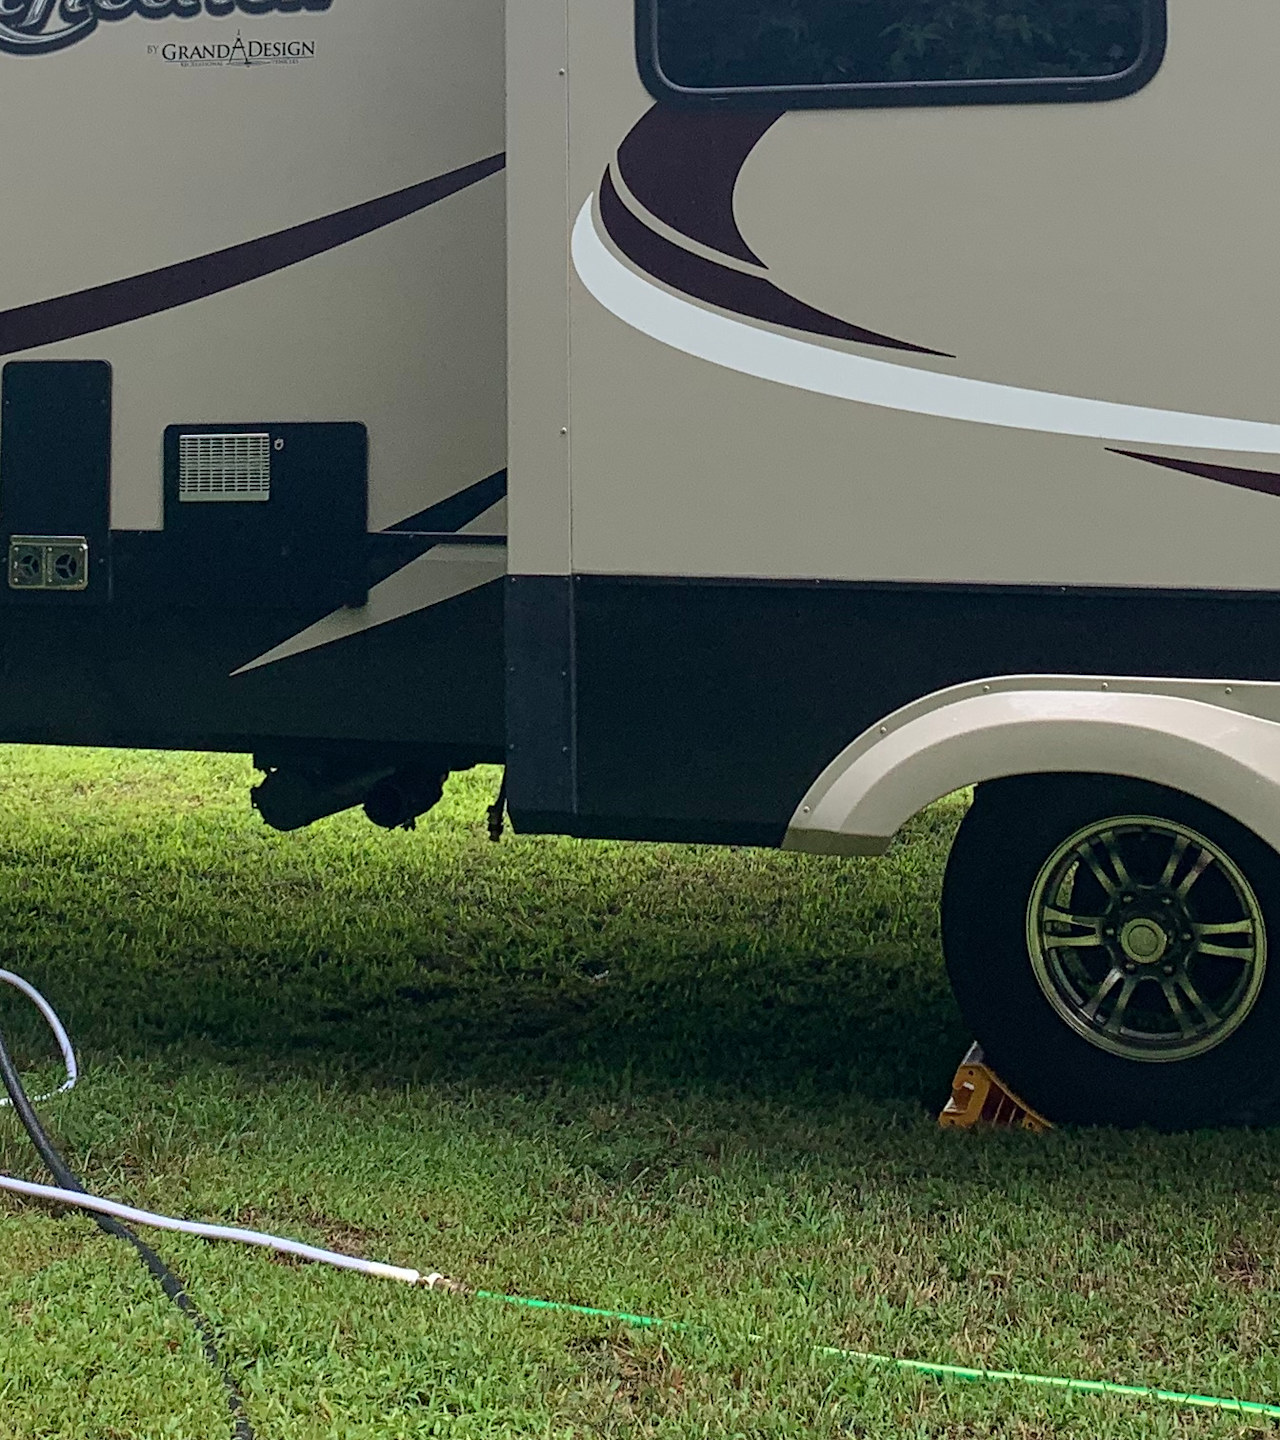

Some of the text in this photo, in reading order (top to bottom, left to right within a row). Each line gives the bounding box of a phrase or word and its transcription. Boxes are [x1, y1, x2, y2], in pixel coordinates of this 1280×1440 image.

[146, 40, 315, 61] BY GRAND DESIGN
